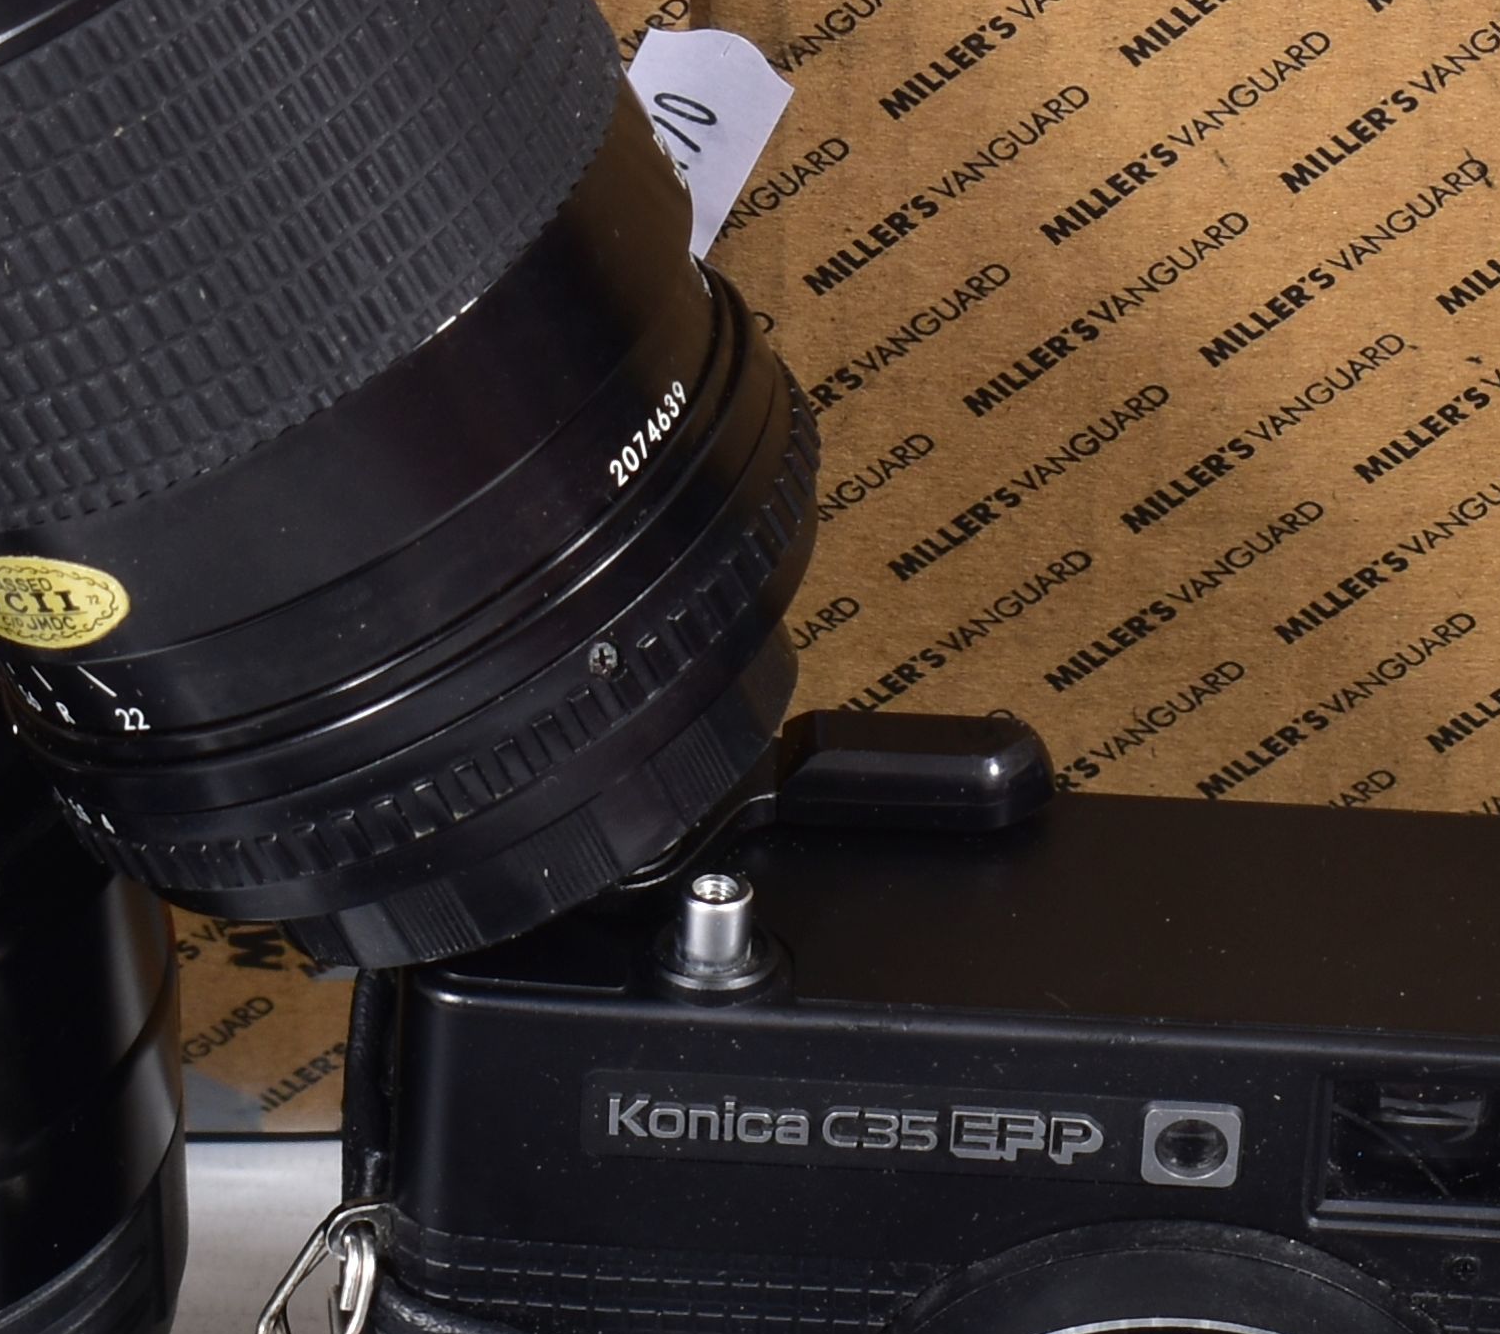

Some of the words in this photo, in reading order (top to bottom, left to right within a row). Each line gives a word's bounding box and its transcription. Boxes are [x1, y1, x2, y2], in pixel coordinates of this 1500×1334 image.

[878, 15, 1017, 121] MILLER'S
[802, 194, 939, 297] MILLER'S
[927, 85, 1090, 199] VANGUARD
[1039, 142, 1178, 246] MILLER'S
[1167, 31, 1331, 147] VANGUARD
[1278, 89, 1419, 194] MILLER'S
[608, 380, 688, 488] 2074639
[1119, 437, 1256, 535] MILLER'S
[1244, 334, 1405, 442] VANGUARD
[1352, 386, 1491, 485] MILLER'S
[26, 615, 77, 633] JMDC
[114, 707, 151, 731] 22
[1196, 709, 1330, 789] MILLER'S
[1318, 612, 1477, 714] VANGUARD
[606, 1091, 810, 1146] Konica
[821, 1105, 940, 1153] C35
[947, 1104, 1106, 1166] EFP
